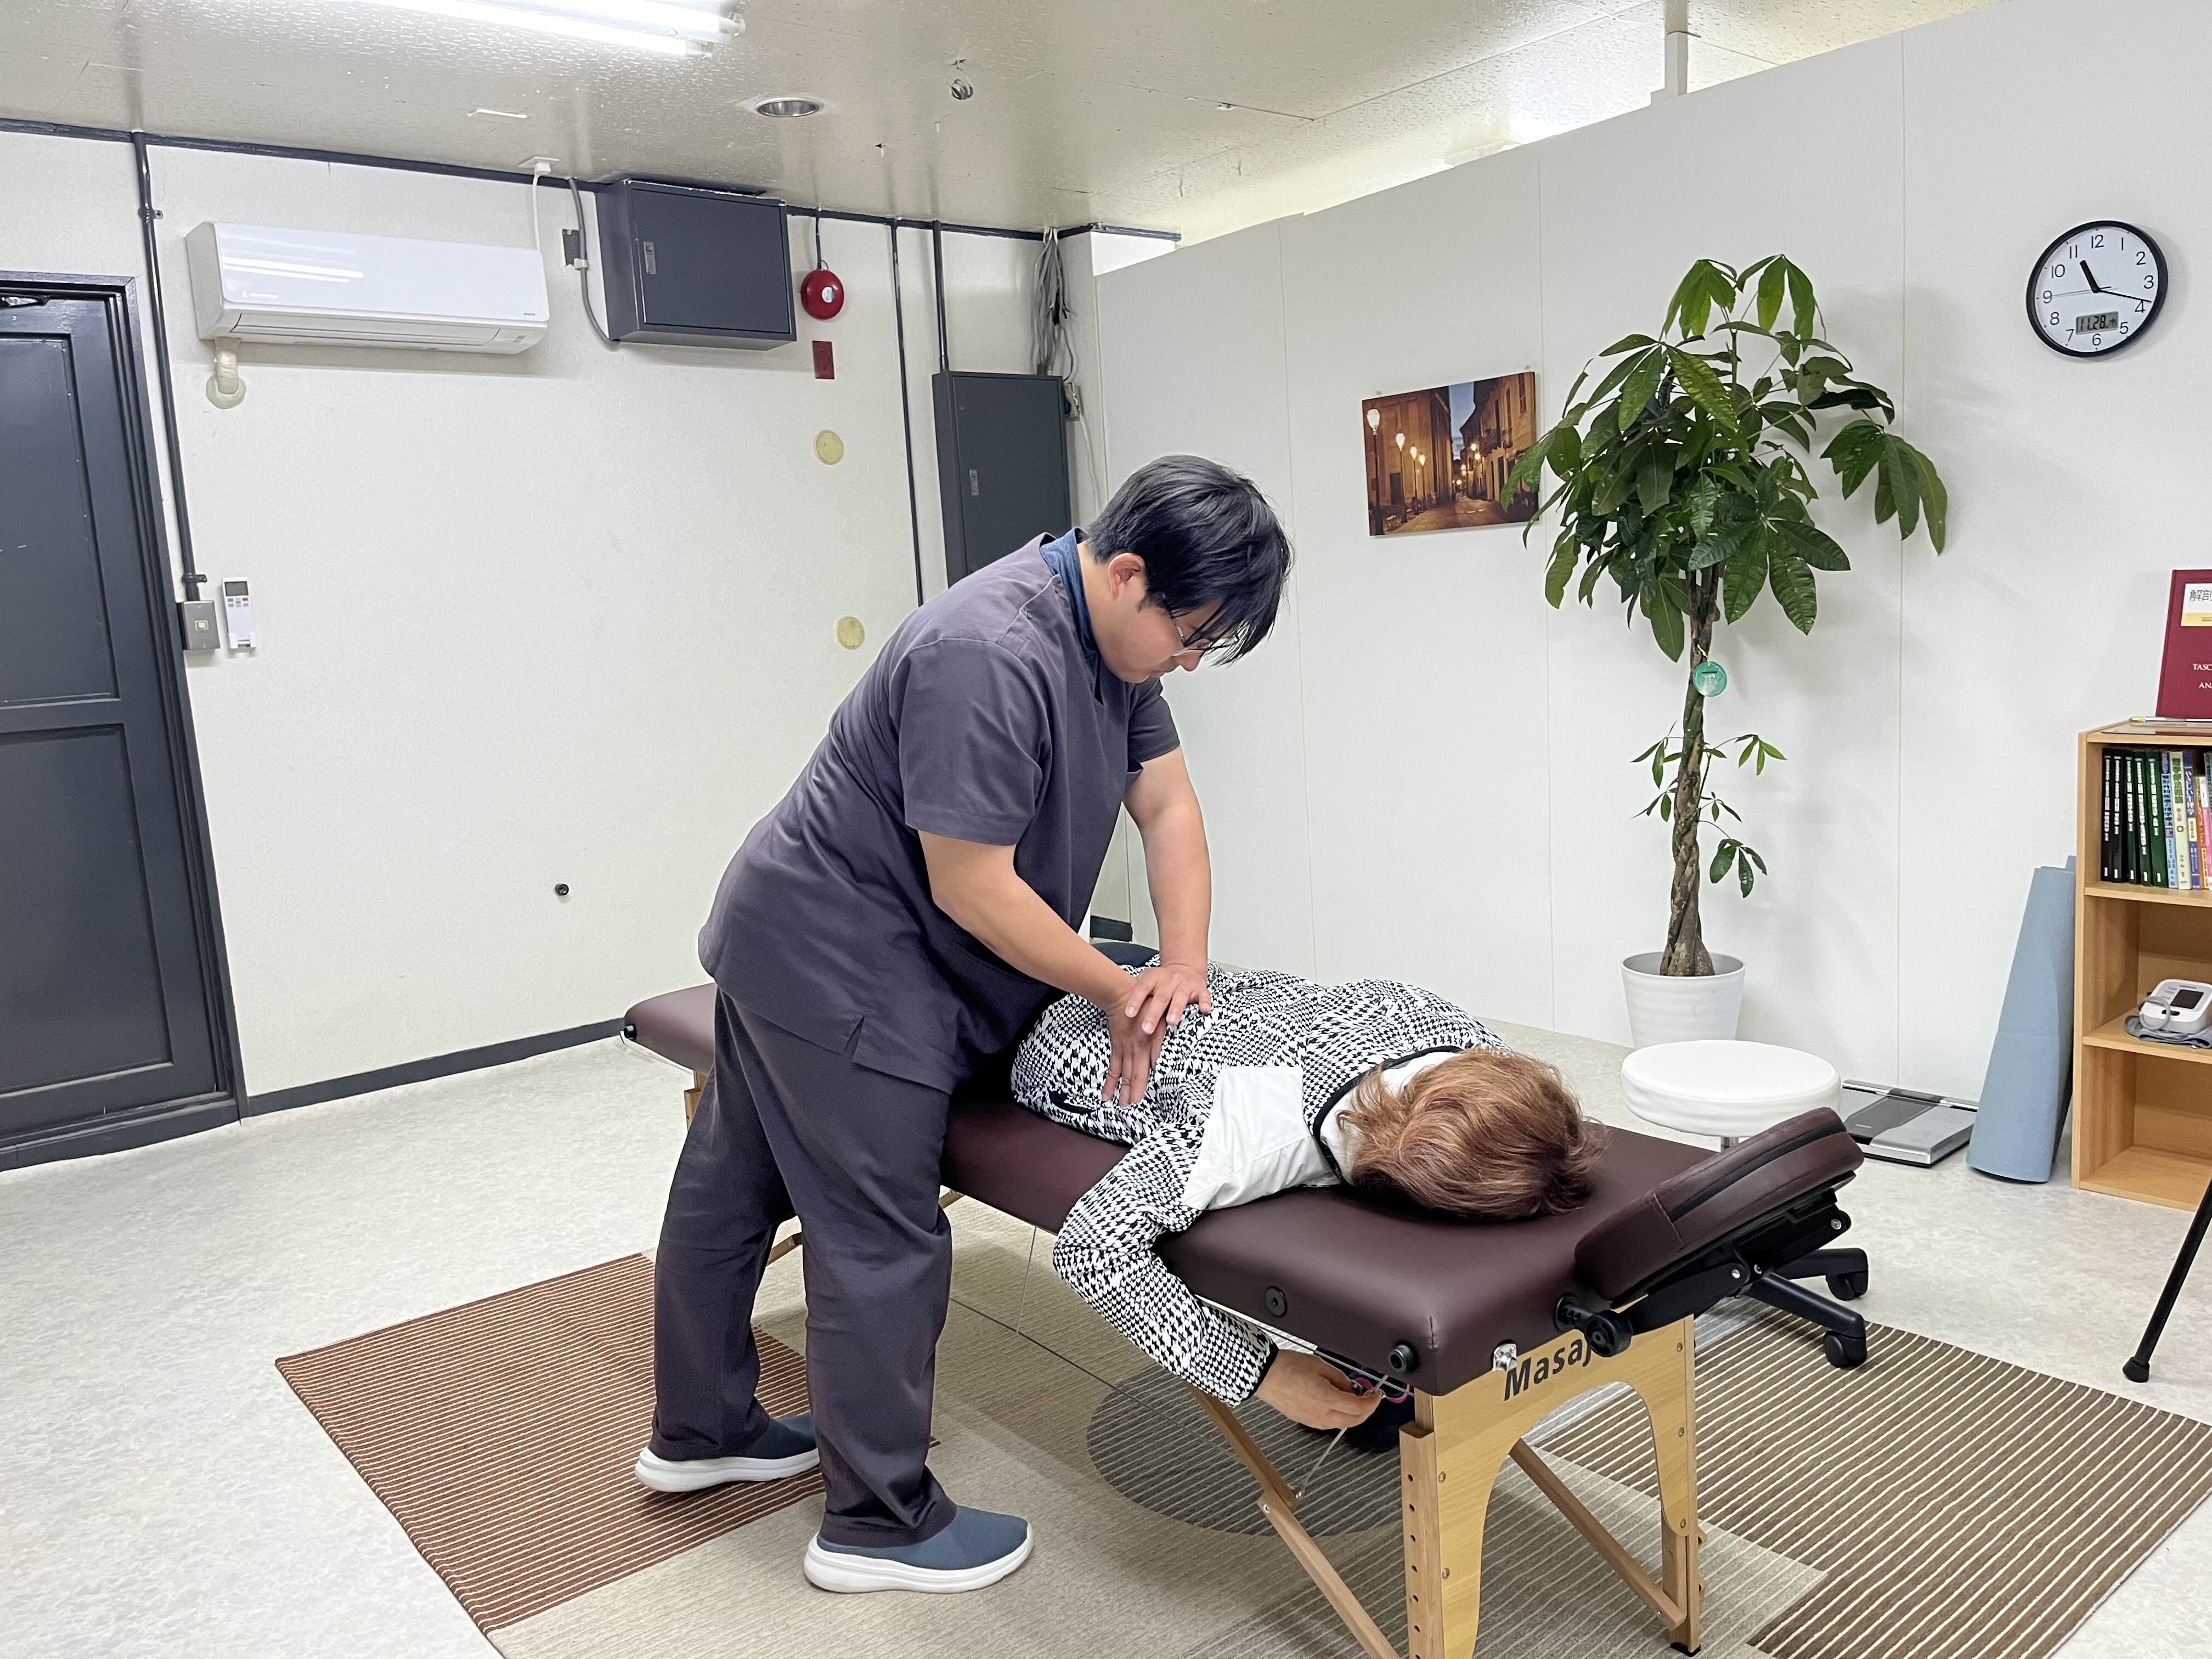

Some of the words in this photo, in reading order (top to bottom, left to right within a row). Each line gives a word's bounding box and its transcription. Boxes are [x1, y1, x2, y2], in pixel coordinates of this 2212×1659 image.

[2091, 234, 2104, 249] 12
[2121, 237, 2124, 251] 1
[2069, 245, 2078, 259] 11
[2136, 251, 2146, 266] 2
[2051, 264, 2065, 279] 10
[2143, 275, 2154, 289] 3
[2042, 290, 2052, 303] 9
[2135, 300, 2145, 313] 4
[2050, 312, 2059, 326] 8
[2119, 321, 2129, 335] 5
[2066, 329, 2074, 342] 7
[2092, 333, 2101, 346] 6
